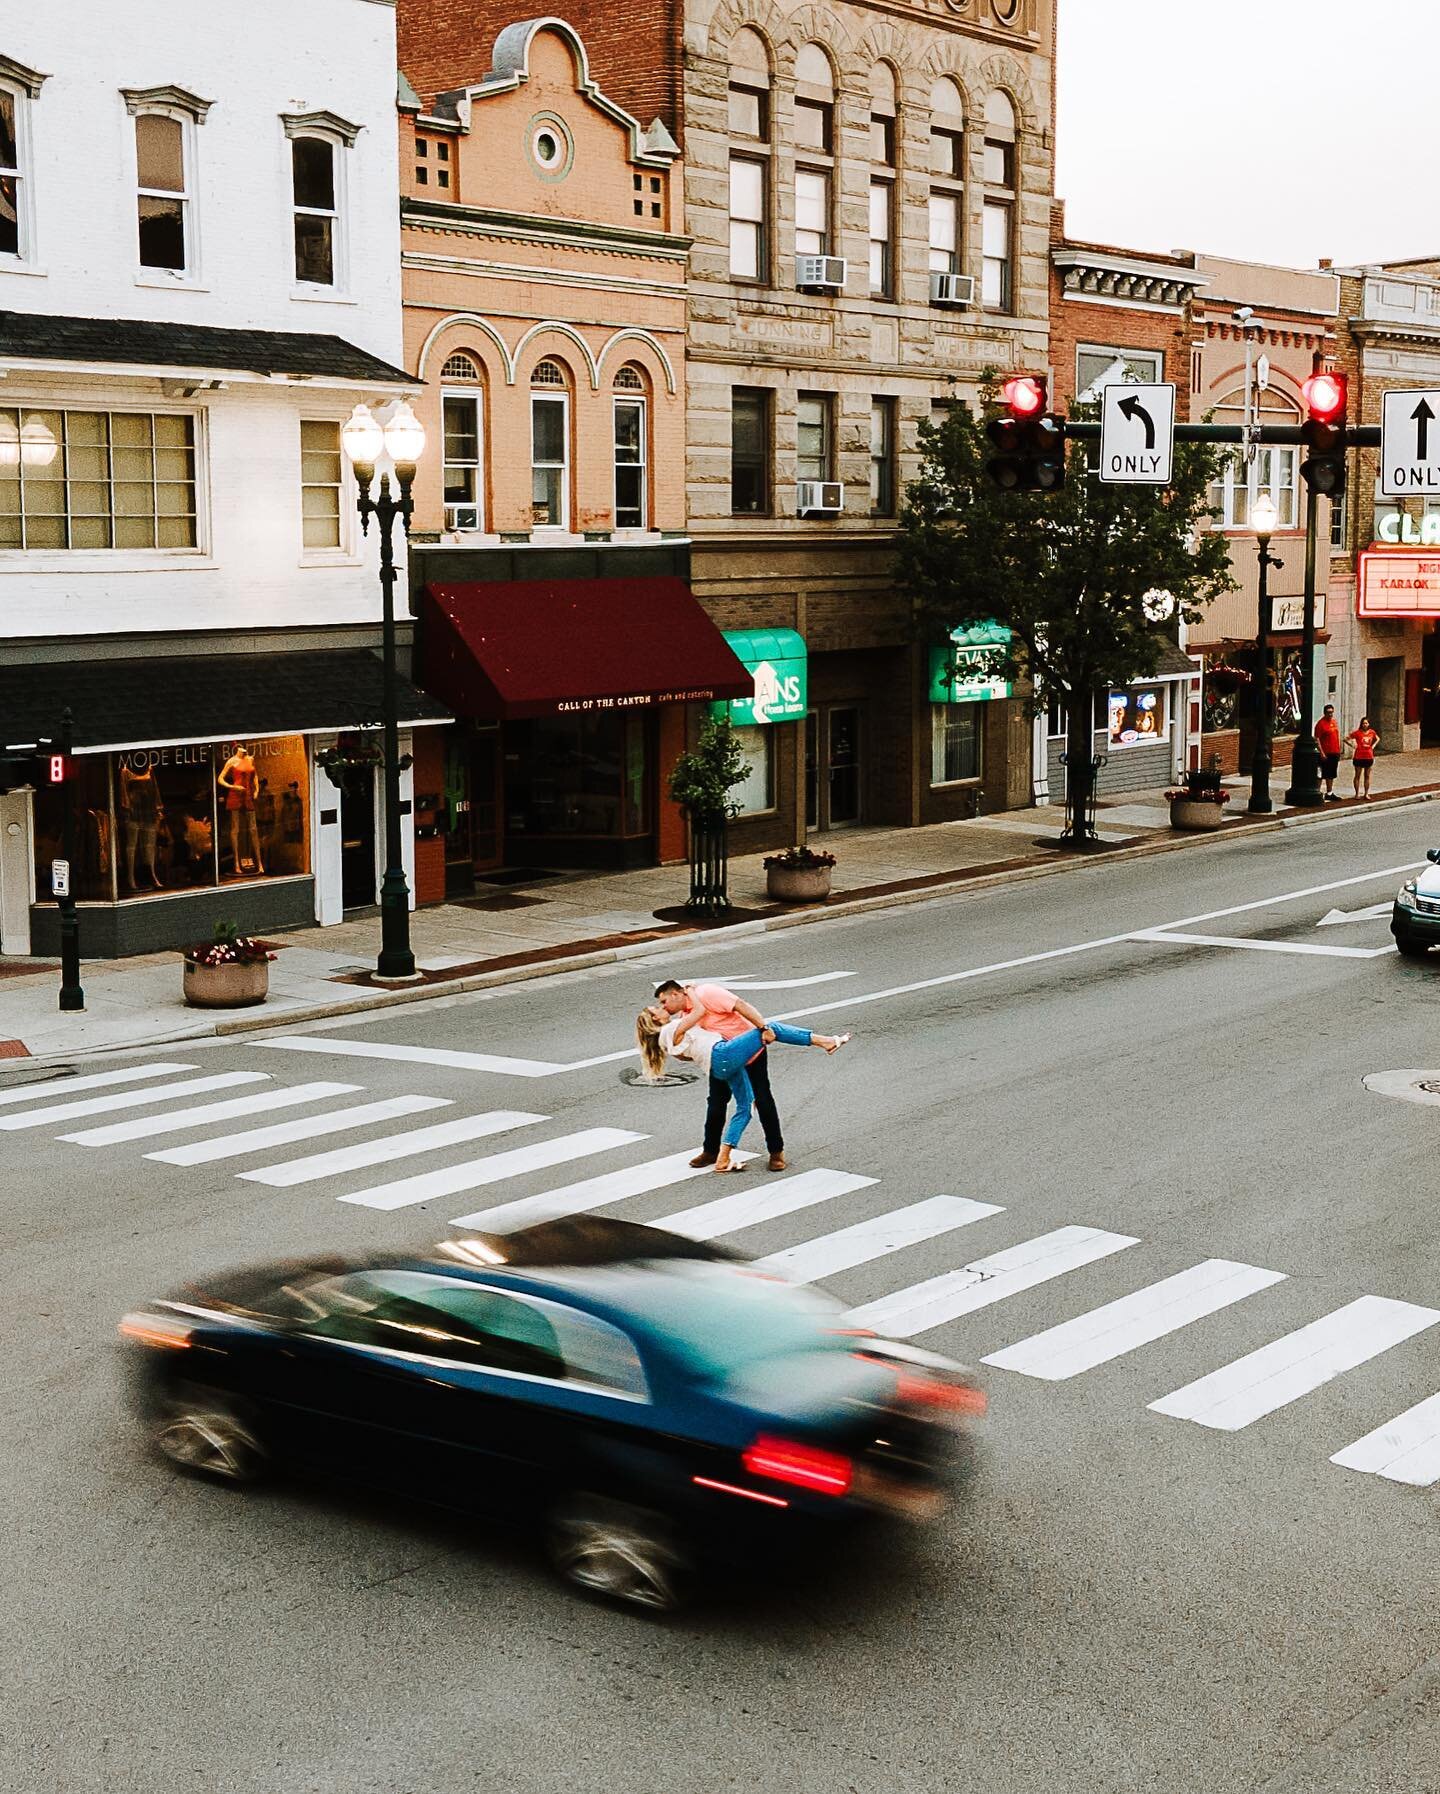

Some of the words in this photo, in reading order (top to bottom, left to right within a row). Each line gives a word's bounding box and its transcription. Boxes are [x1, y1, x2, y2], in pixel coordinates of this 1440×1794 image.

[1111, 455, 1161, 473] ONLY
[1394, 467, 1440, 487] ONL
[1418, 563, 1440, 573] NIG
[558, 701, 580, 711] CALL
[582, 700, 594, 709] OF
[596, 698, 614, 708] THE
[617, 695, 651, 706] CANYON
[118, 751, 169, 769] MODE
[175, 745, 208, 765] ELLE
[51, 756, 63, 782] 8
